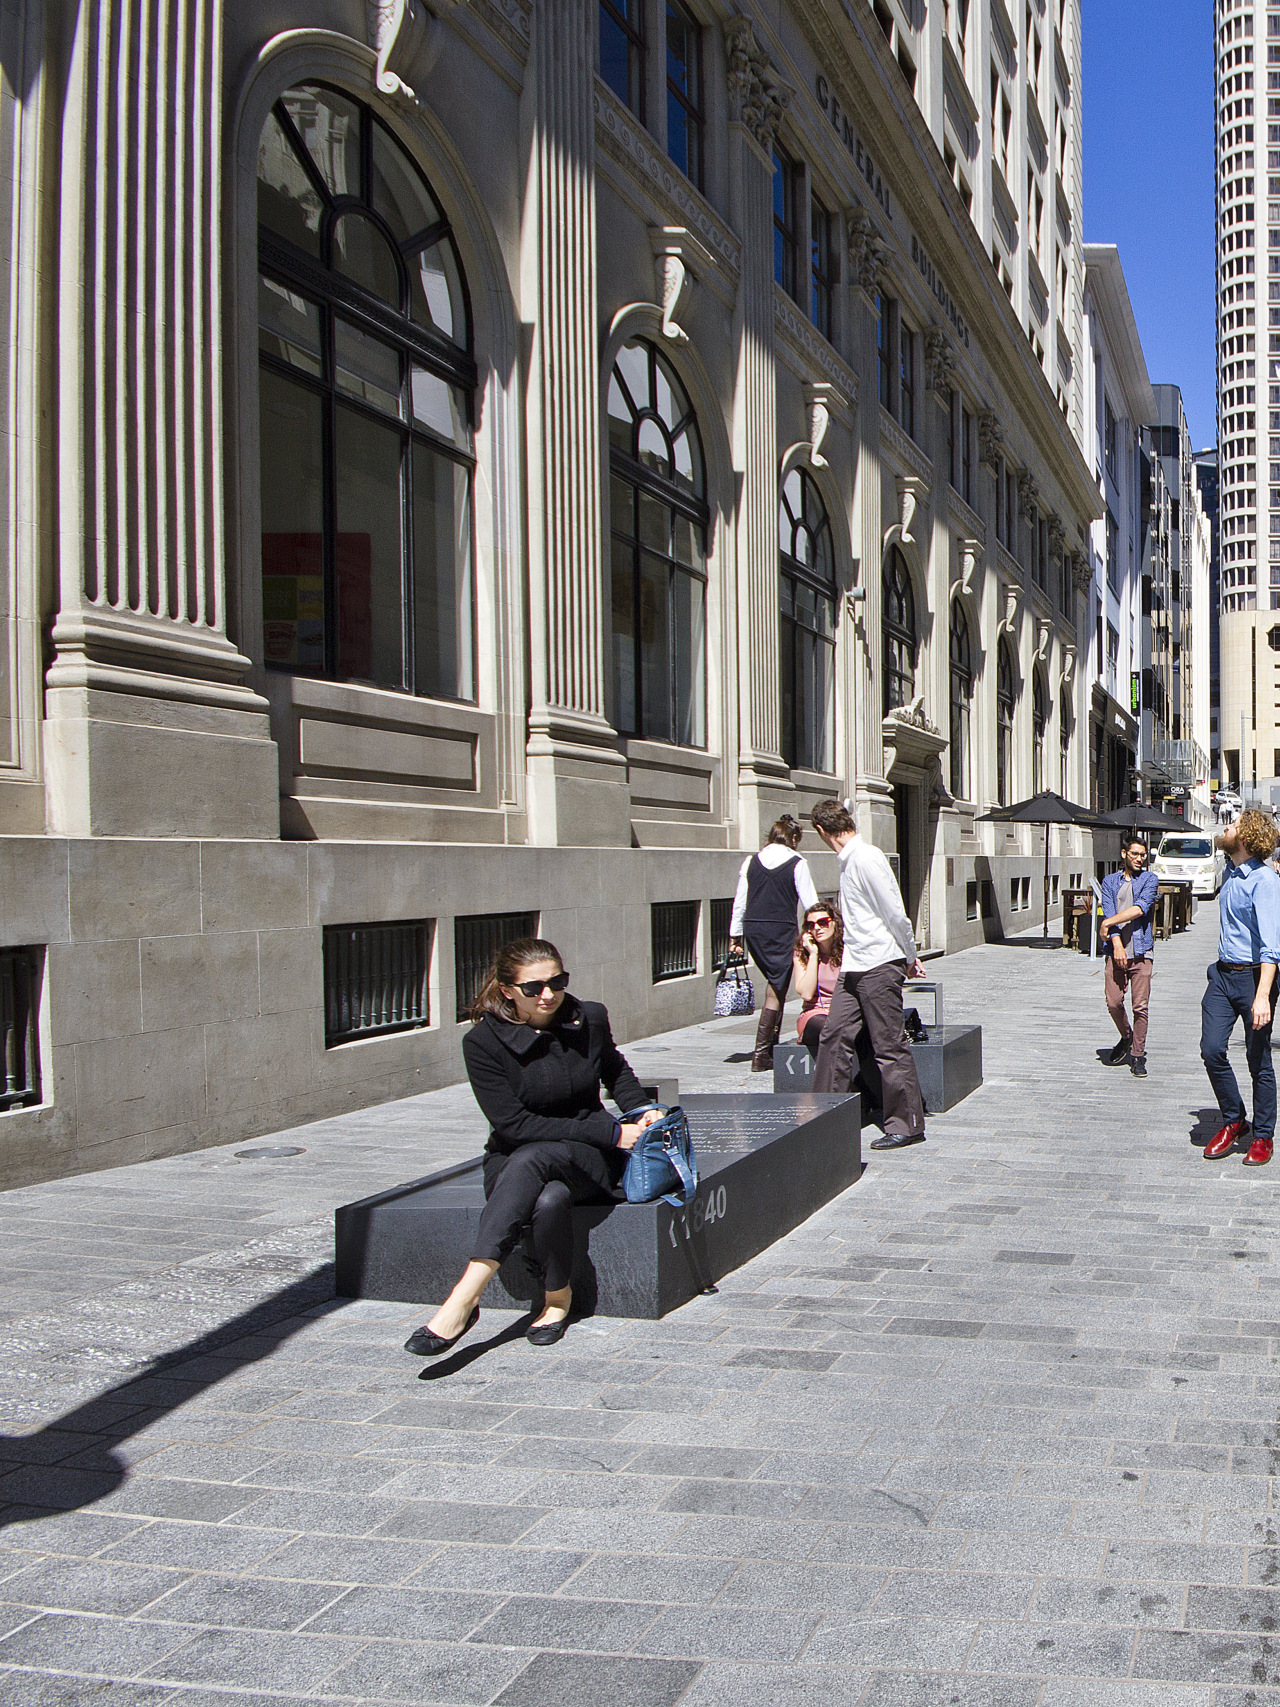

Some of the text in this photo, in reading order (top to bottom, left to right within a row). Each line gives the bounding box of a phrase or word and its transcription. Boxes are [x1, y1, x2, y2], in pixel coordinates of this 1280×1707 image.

[815, 75, 970, 348] GENERAL BUILDINGS
[681, 1185, 727, 1240] 1840
